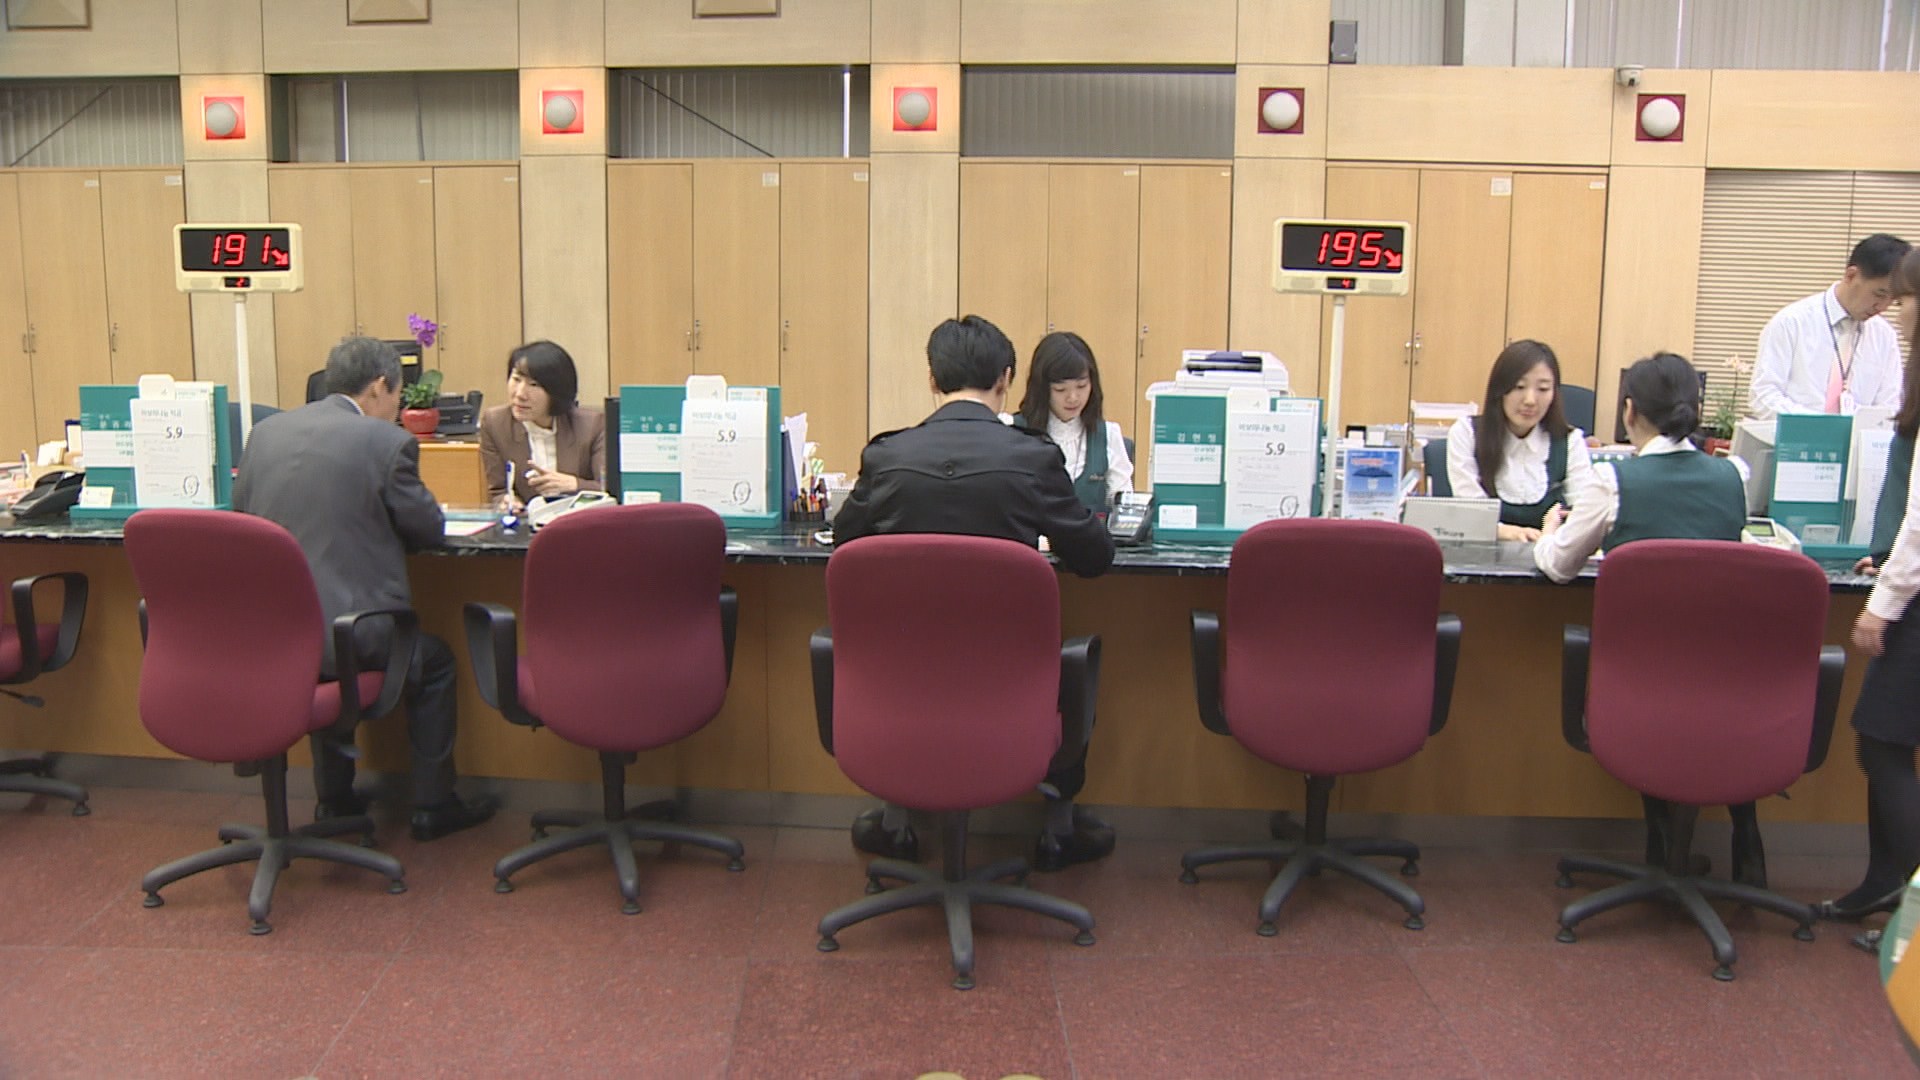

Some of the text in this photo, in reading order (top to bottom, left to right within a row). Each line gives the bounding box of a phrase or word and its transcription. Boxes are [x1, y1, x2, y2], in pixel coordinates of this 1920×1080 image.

[212, 234, 271, 265] 191
[1318, 231, 1384, 267] 195
[1341, 279, 1351, 289] 4
[165, 426, 183, 439] 5.9
[717, 429, 736, 442] 5.9
[1265, 442, 1285, 455] 5.9
